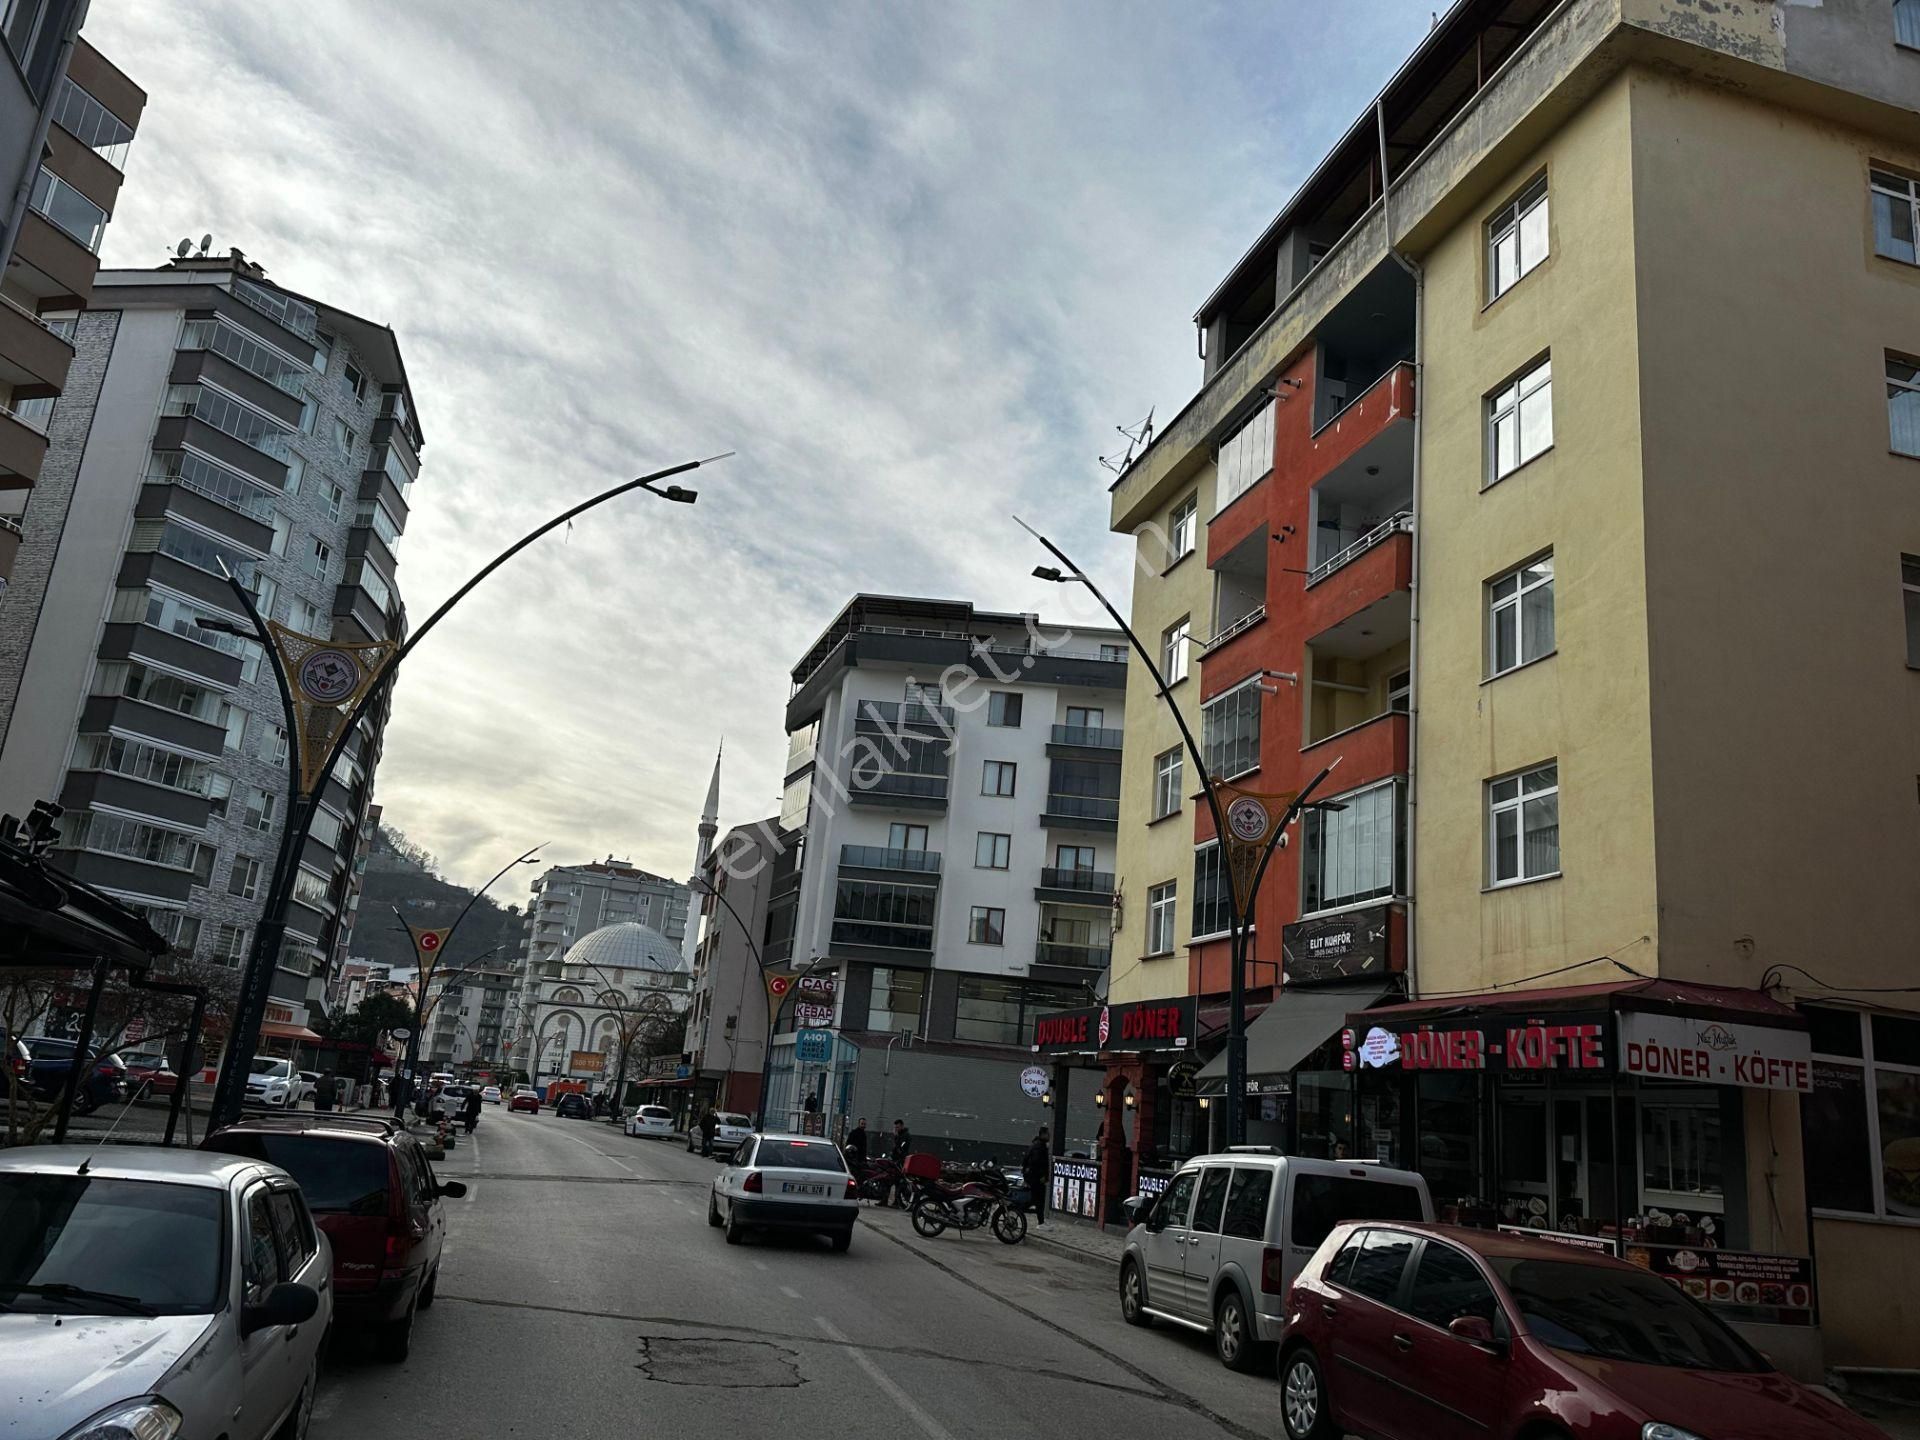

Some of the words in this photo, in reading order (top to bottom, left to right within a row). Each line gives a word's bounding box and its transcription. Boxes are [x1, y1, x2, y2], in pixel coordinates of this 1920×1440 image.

[796, 1004, 833, 1019] KEBAP
[1038, 1015, 1089, 1046] DOUBLE
[1121, 1003, 1182, 1041] DÖNER
[1401, 1024, 1486, 1070] DÖNER
[1506, 1018, 1605, 1069] KÖFTE
[1627, 1038, 1710, 1079] DÖNER
[1734, 1050, 1809, 1089] KÖFTE
[1023, 1068, 1047, 1078] DOUBLE
[1024, 1077, 1046, 1086] DÖNER
[1053, 1162, 1077, 1177] DOUBLE
[1076, 1163, 1098, 1181] DÖNER
[1139, 1175, 1163, 1193] DOUBLE
